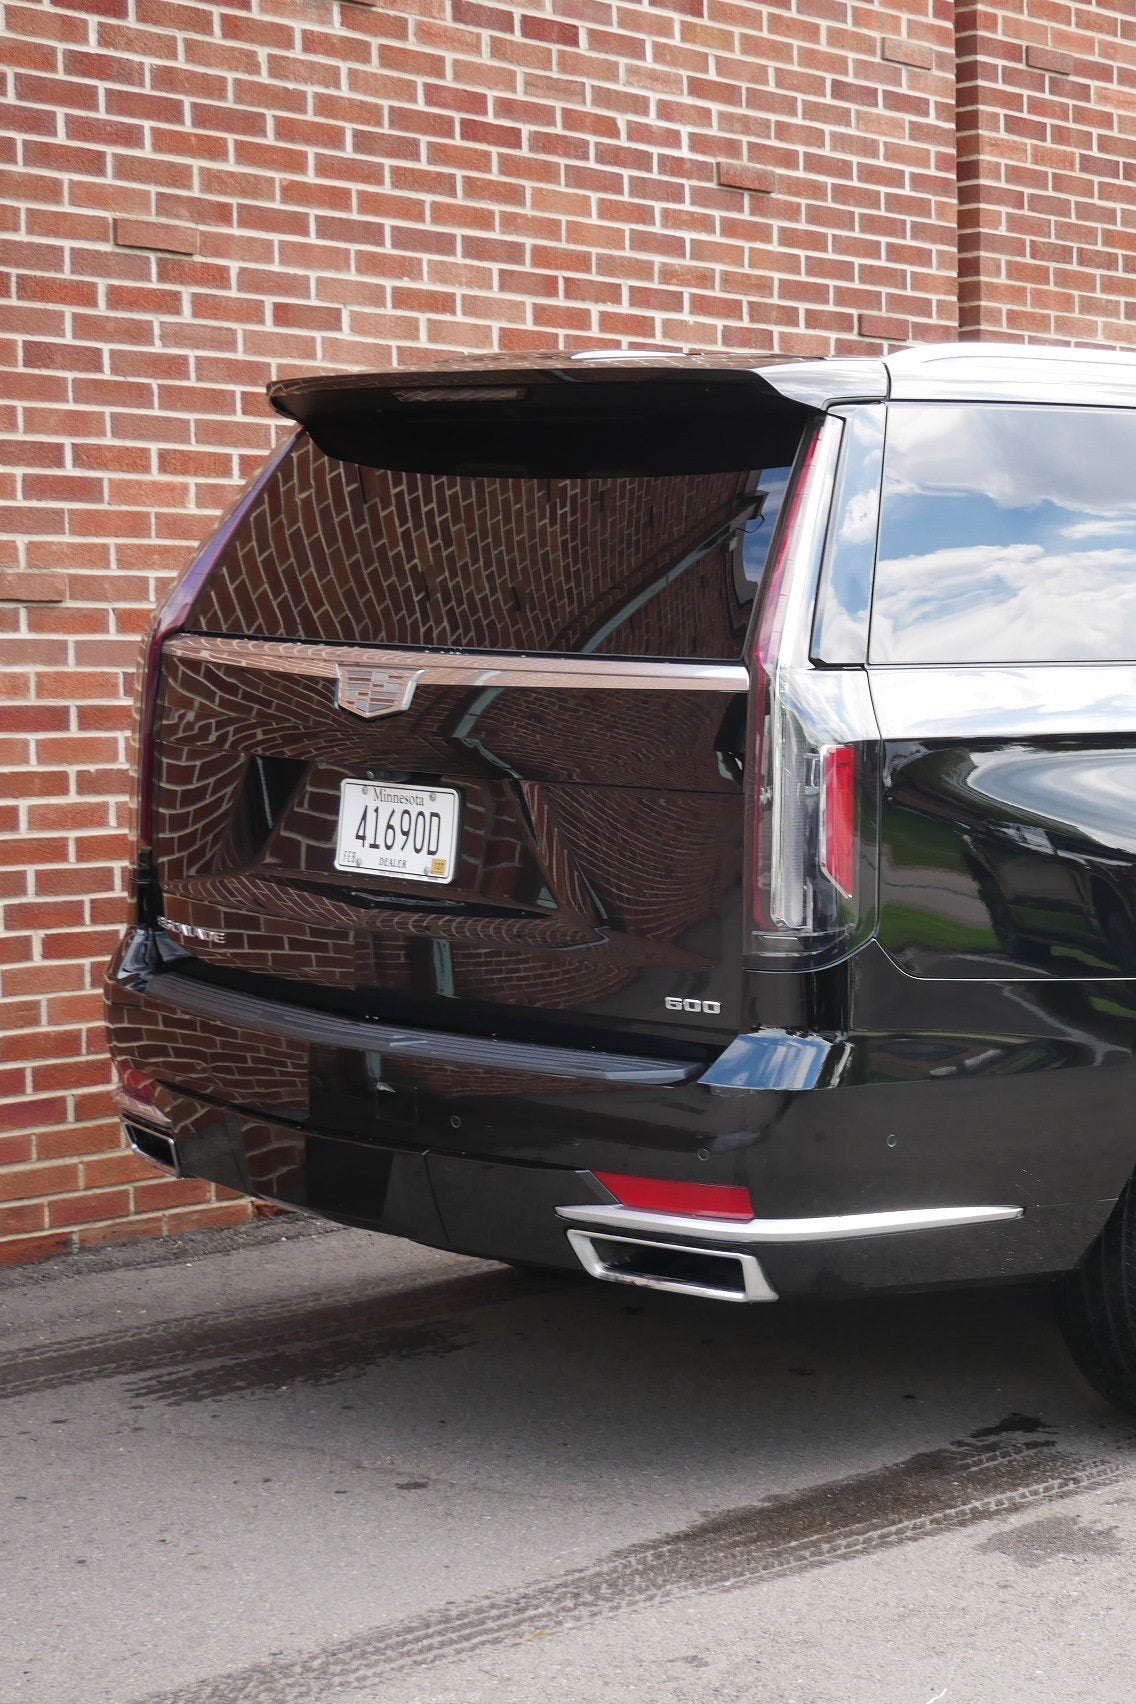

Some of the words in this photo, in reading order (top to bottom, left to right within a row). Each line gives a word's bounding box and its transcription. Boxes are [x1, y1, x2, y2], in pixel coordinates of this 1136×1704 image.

[373, 787, 424, 806] Minnesota
[355, 804, 441, 856] 41690D
[379, 857, 407, 869] DEALER
[664, 996, 721, 1015] 600
